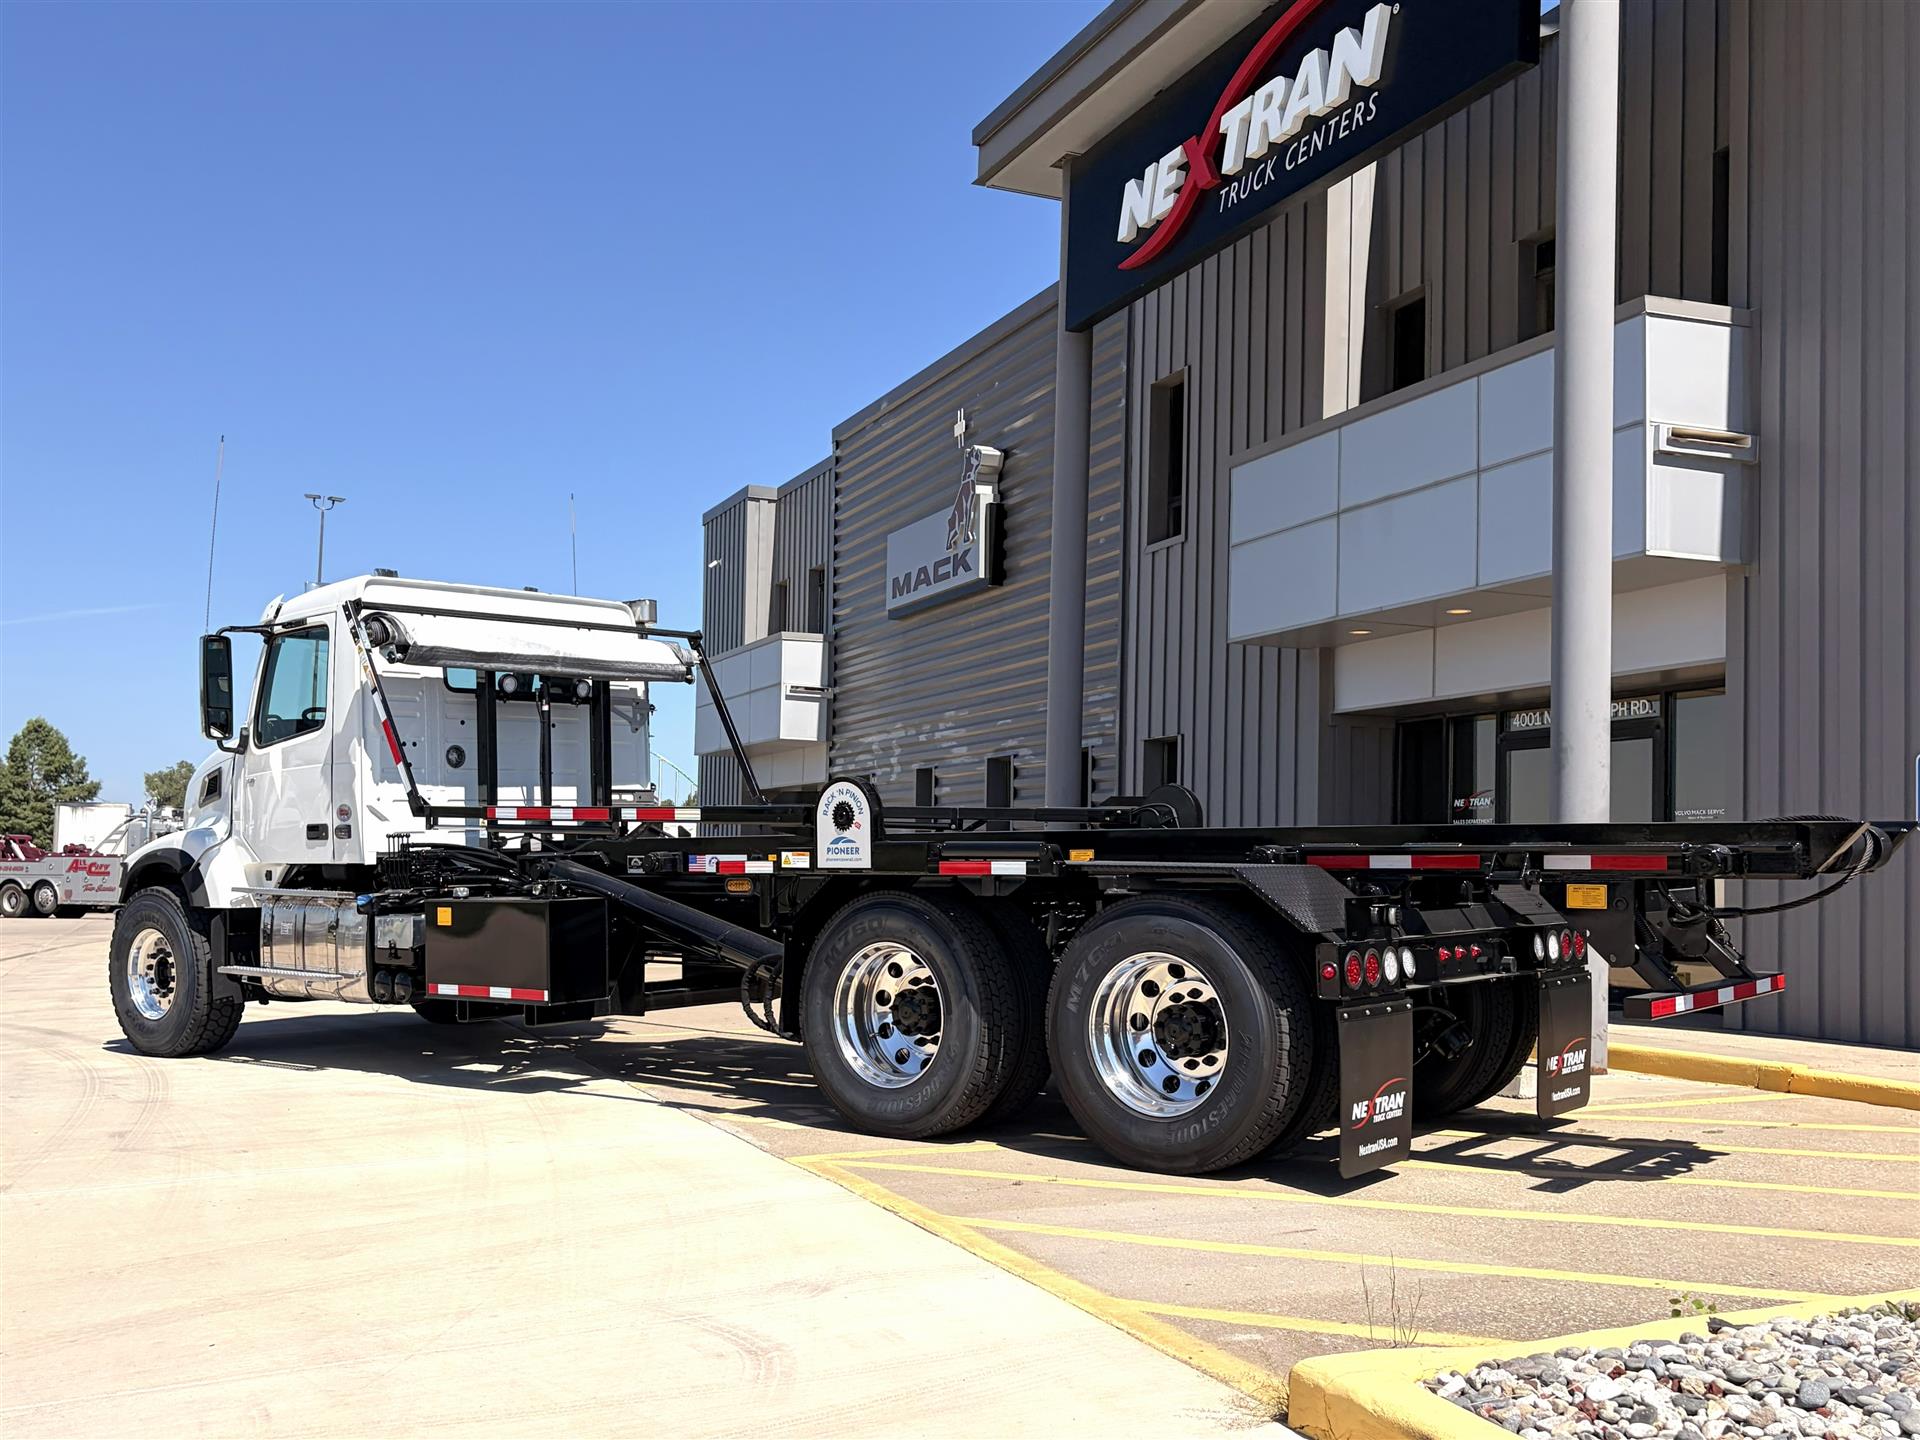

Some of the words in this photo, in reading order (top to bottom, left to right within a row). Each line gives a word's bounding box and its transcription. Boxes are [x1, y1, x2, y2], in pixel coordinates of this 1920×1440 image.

[1117, 3, 1392, 243] NEXTRAN
[1219, 156, 1277, 213] TRUCK
[1285, 91, 1379, 171] CENTERS
[891, 548, 973, 600] MACK
[1513, 712, 1541, 727] 4001
[1630, 700, 1653, 715] RD.
[823, 792, 837, 816] RACK
[845, 789, 864, 815] PINION
[1454, 797, 1491, 807] NEXTRAN
[826, 847, 860, 855] PIONEER
[1545, 1049, 1587, 1072] NEXTRAN
[1352, 1091, 1407, 1120] NEXTRAN
[1359, 1137, 1399, 1157] NextranUSA.com
